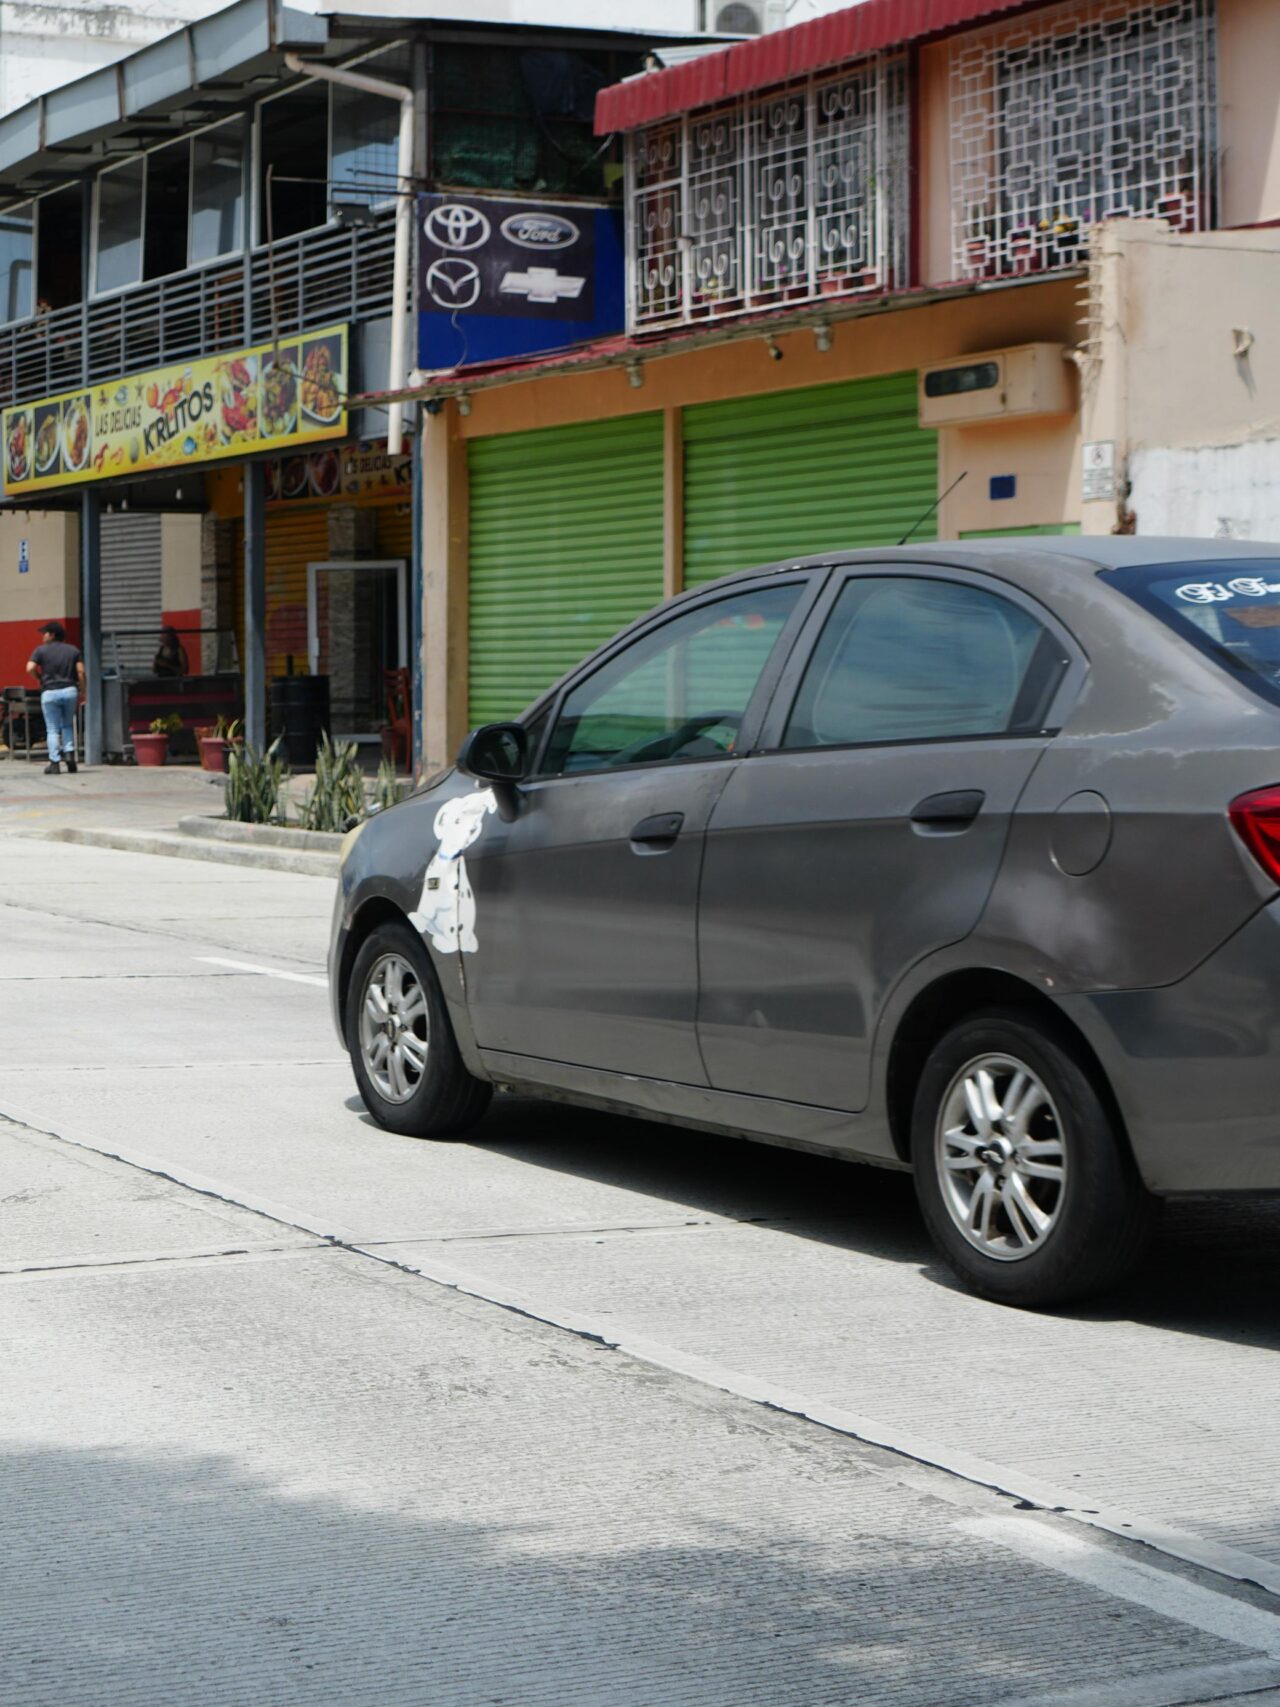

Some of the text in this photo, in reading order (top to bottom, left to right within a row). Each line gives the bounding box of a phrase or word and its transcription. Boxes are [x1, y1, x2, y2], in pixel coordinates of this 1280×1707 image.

[518, 220, 559, 242] Ford
[95, 404, 142, 437] LAS DELICIAS
